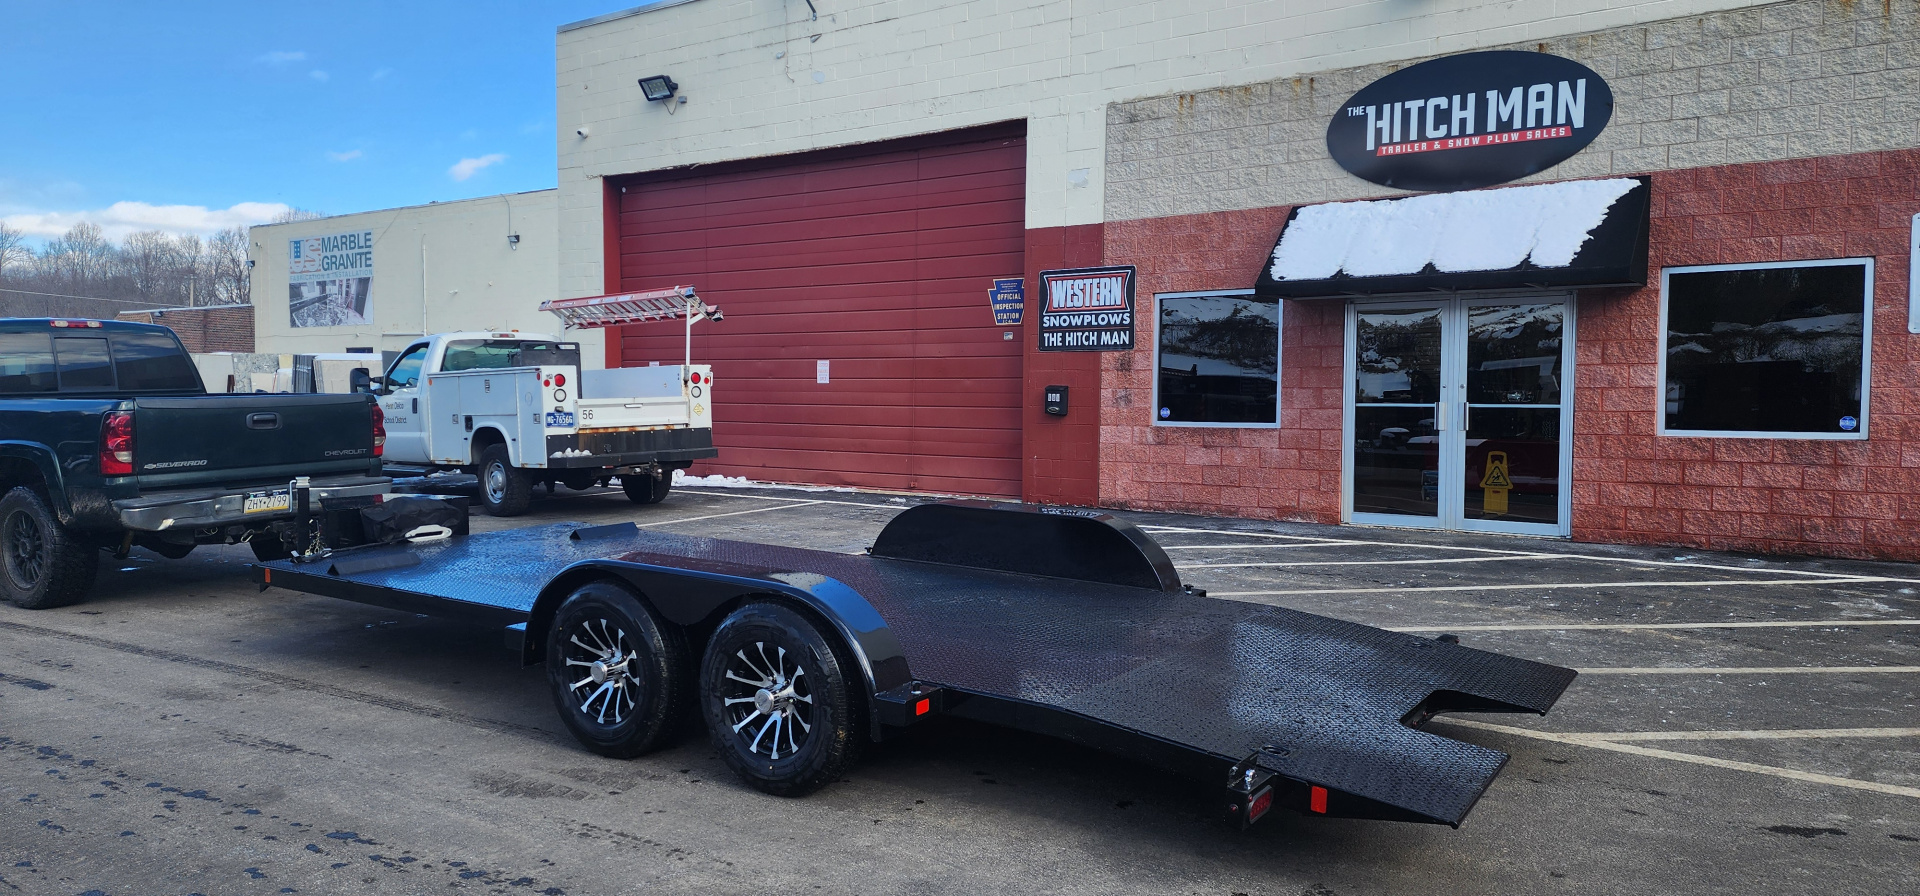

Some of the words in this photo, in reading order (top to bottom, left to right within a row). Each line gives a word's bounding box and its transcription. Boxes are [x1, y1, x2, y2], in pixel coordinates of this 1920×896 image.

[1347, 106, 1365, 117] THE
[1366, 92, 1476, 151] HITCH
[1486, 78, 1586, 132] MAN
[1382, 142, 1427, 155] TRAILER
[1433, 141, 1441, 149] &
[1448, 137, 1480, 147] SNOW
[1487, 132, 1519, 143] PLOW
[1526, 127, 1566, 139] SALES
[321, 232, 372, 253] MARBLE
[290, 238, 321, 274] US
[321, 251, 372, 271] GRANITE
[1051, 277, 1122, 309] WESTERN
[1043, 313, 1130, 327] SNOWPLOWS
[1044, 332, 1063, 346] THE
[1065, 331, 1097, 346] HITCH
[1100, 330, 1129, 345] MAN
[582, 409, 594, 420] 56
[324, 448, 367, 456] CHEVROLET
[156, 460, 208, 469] SILVERADO
